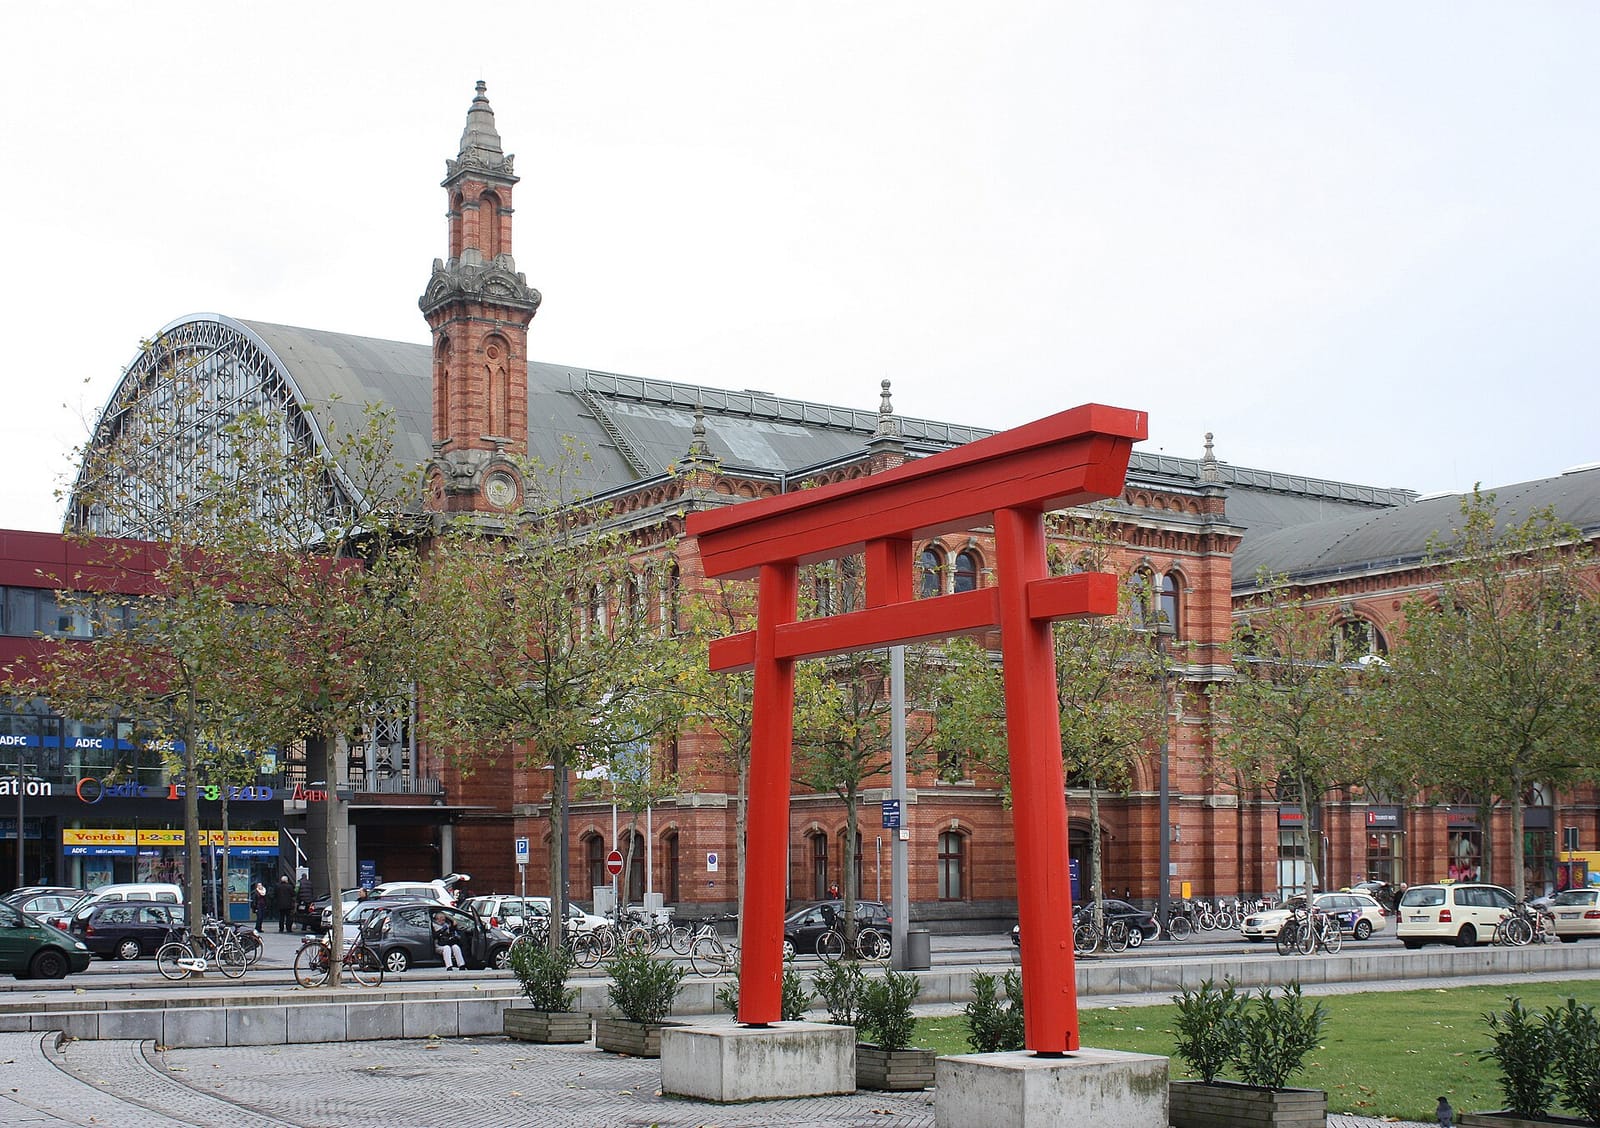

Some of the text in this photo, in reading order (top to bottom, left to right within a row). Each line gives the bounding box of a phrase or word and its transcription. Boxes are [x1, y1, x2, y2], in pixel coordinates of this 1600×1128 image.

[0, 736, 27, 746] ADFC
[75, 738, 102, 748] ADFC
[75, 833, 125, 841] Verleih
[518, 841, 526, 853] P
